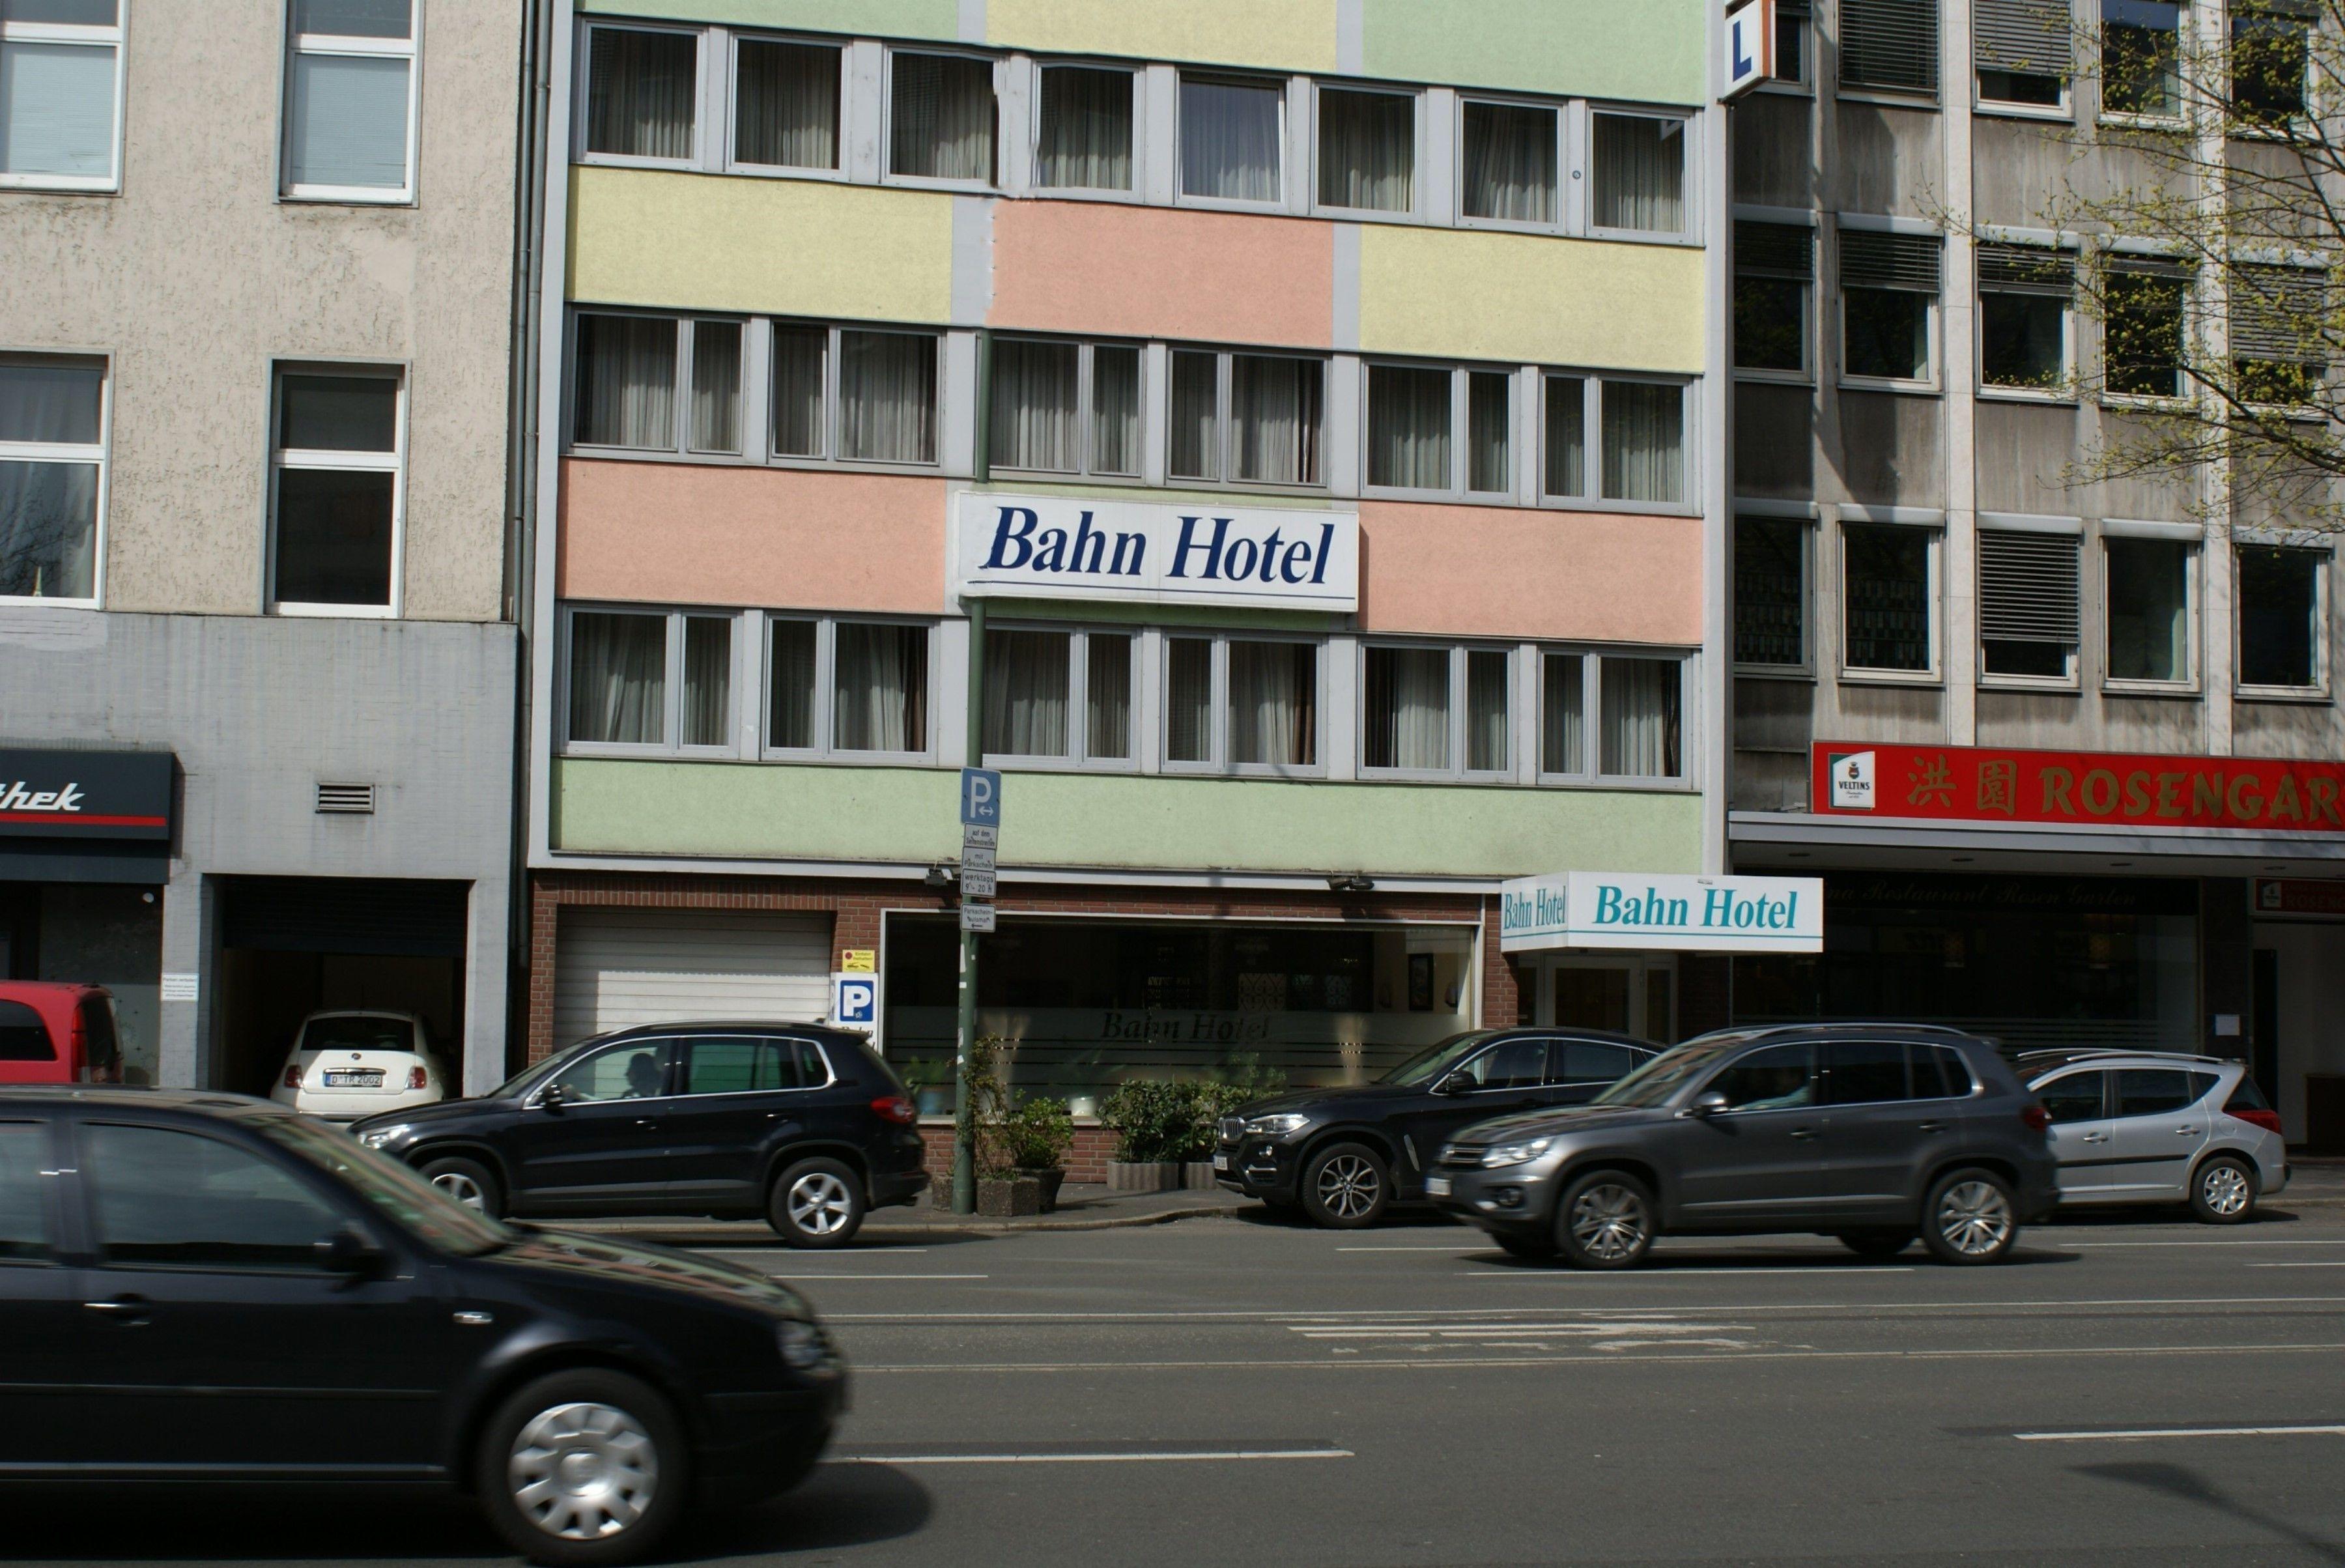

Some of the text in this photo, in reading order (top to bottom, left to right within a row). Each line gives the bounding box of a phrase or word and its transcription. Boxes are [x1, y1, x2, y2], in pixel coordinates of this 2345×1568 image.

[1733, 20, 1752, 82] L
[978, 506, 1335, 584] Bahn Hotel
[971, 776, 991, 818] P
[1839, 780, 1870, 790] VELTINS
[965, 873, 994, 884] werktags
[977, 884, 986, 892] 20
[988, 884, 992, 893] h
[1503, 885, 1566, 930] Bahn Hotel
[1592, 885, 1798, 929] Bahn Hotel
[843, 985, 871, 1017] P
[1100, 1012, 1271, 1040] Bahn Hotel
[357, 1076, 380, 1084] 2002
